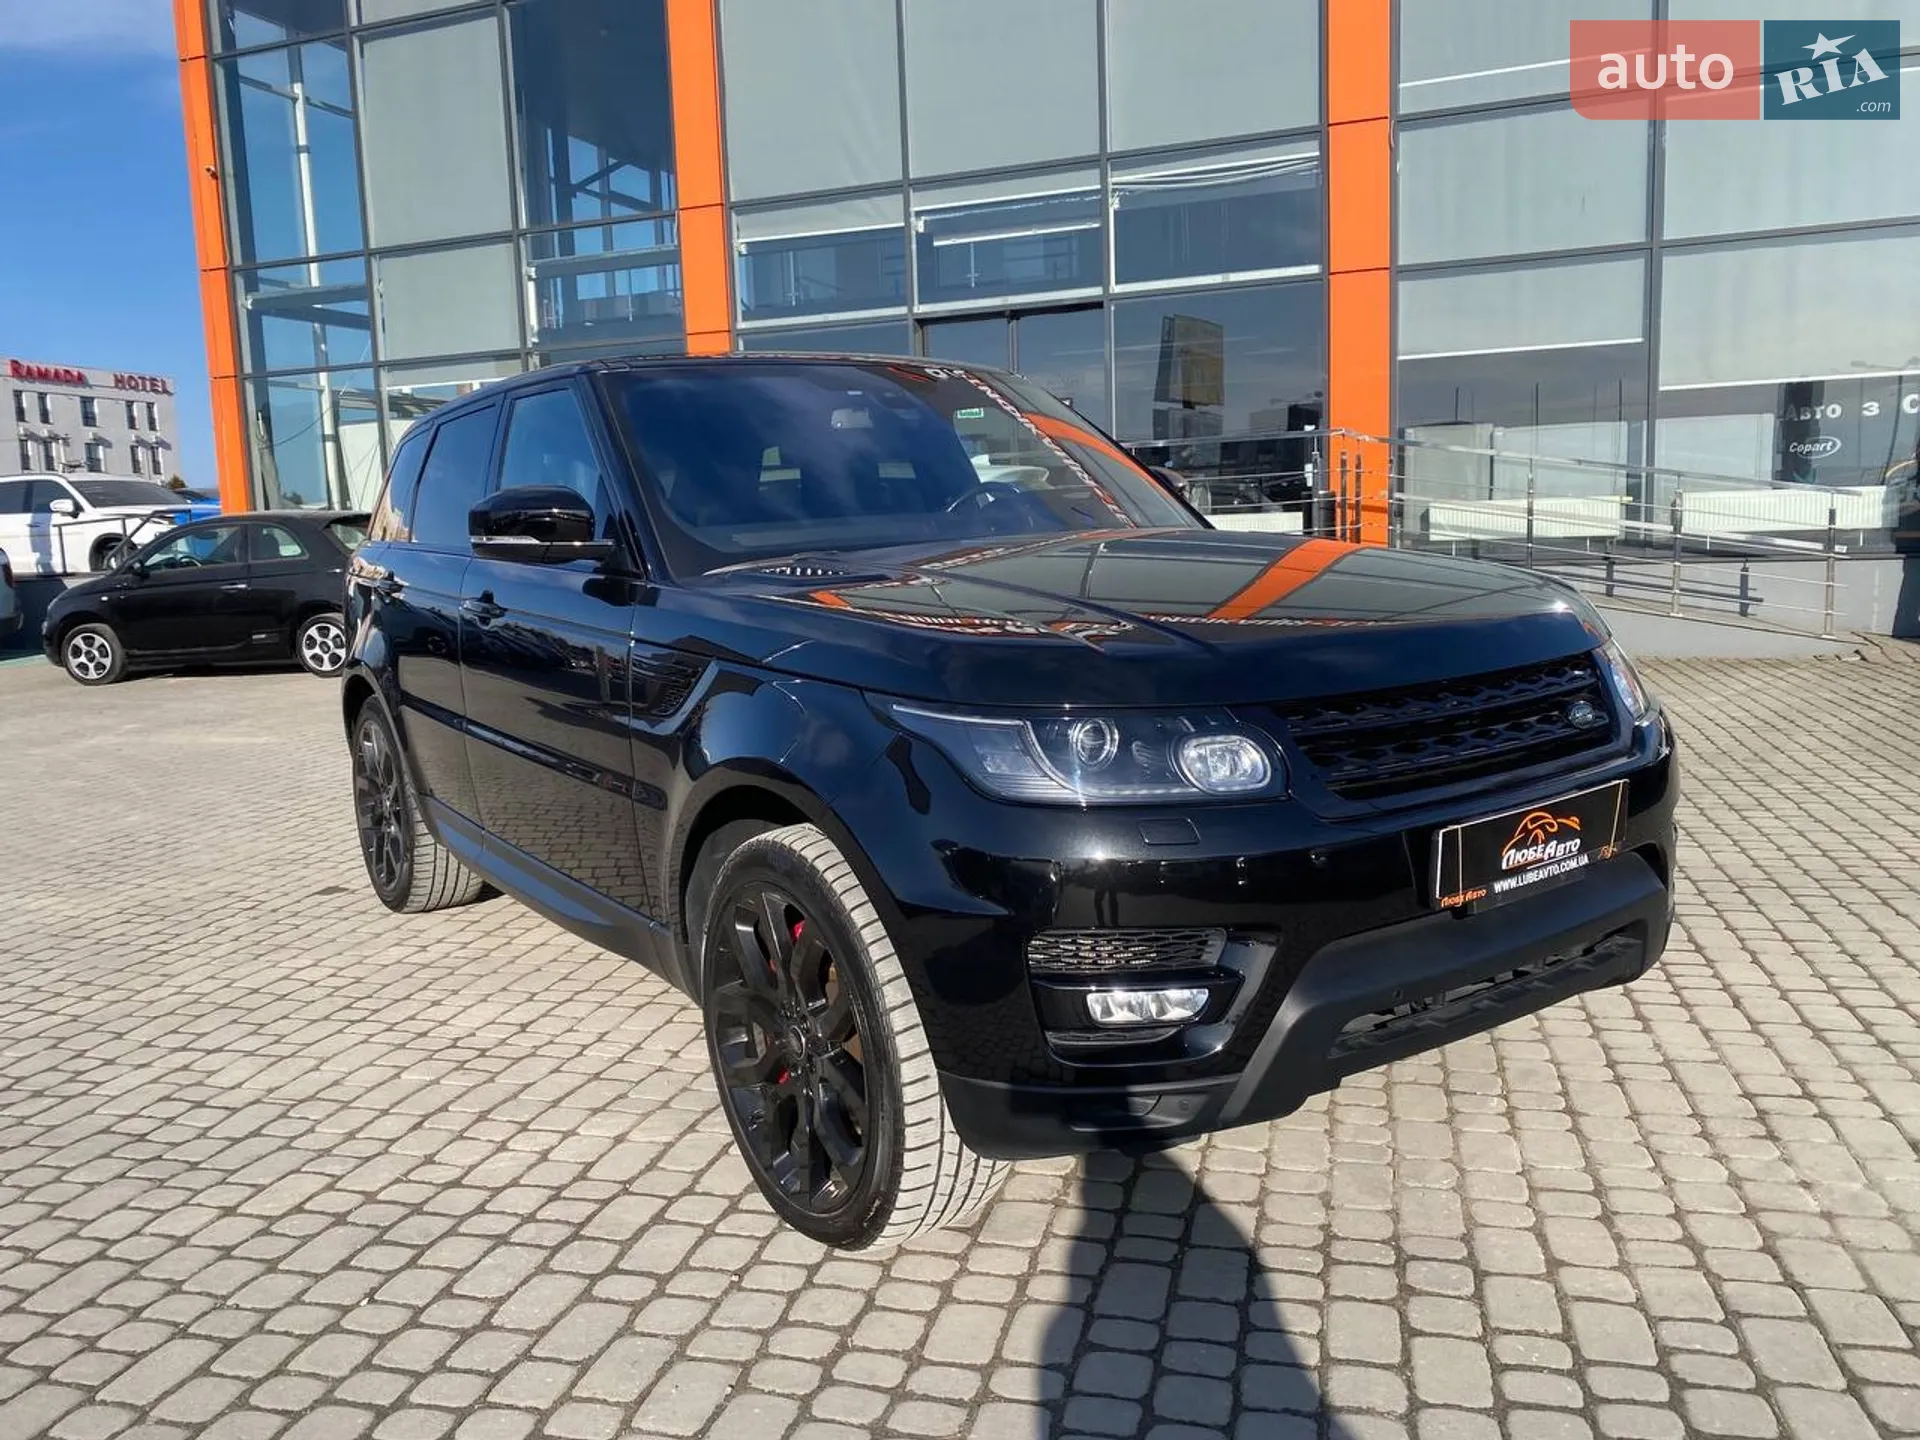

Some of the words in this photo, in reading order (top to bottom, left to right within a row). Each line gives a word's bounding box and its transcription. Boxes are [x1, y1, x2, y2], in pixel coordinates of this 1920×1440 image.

[9, 359, 86, 385] RAMADA
[113, 373, 173, 395] HOTEL
[1789, 441, 1833, 454] Copart
[1493, 854, 1590, 894] WWW.LUBEAVTO.COM.UA
